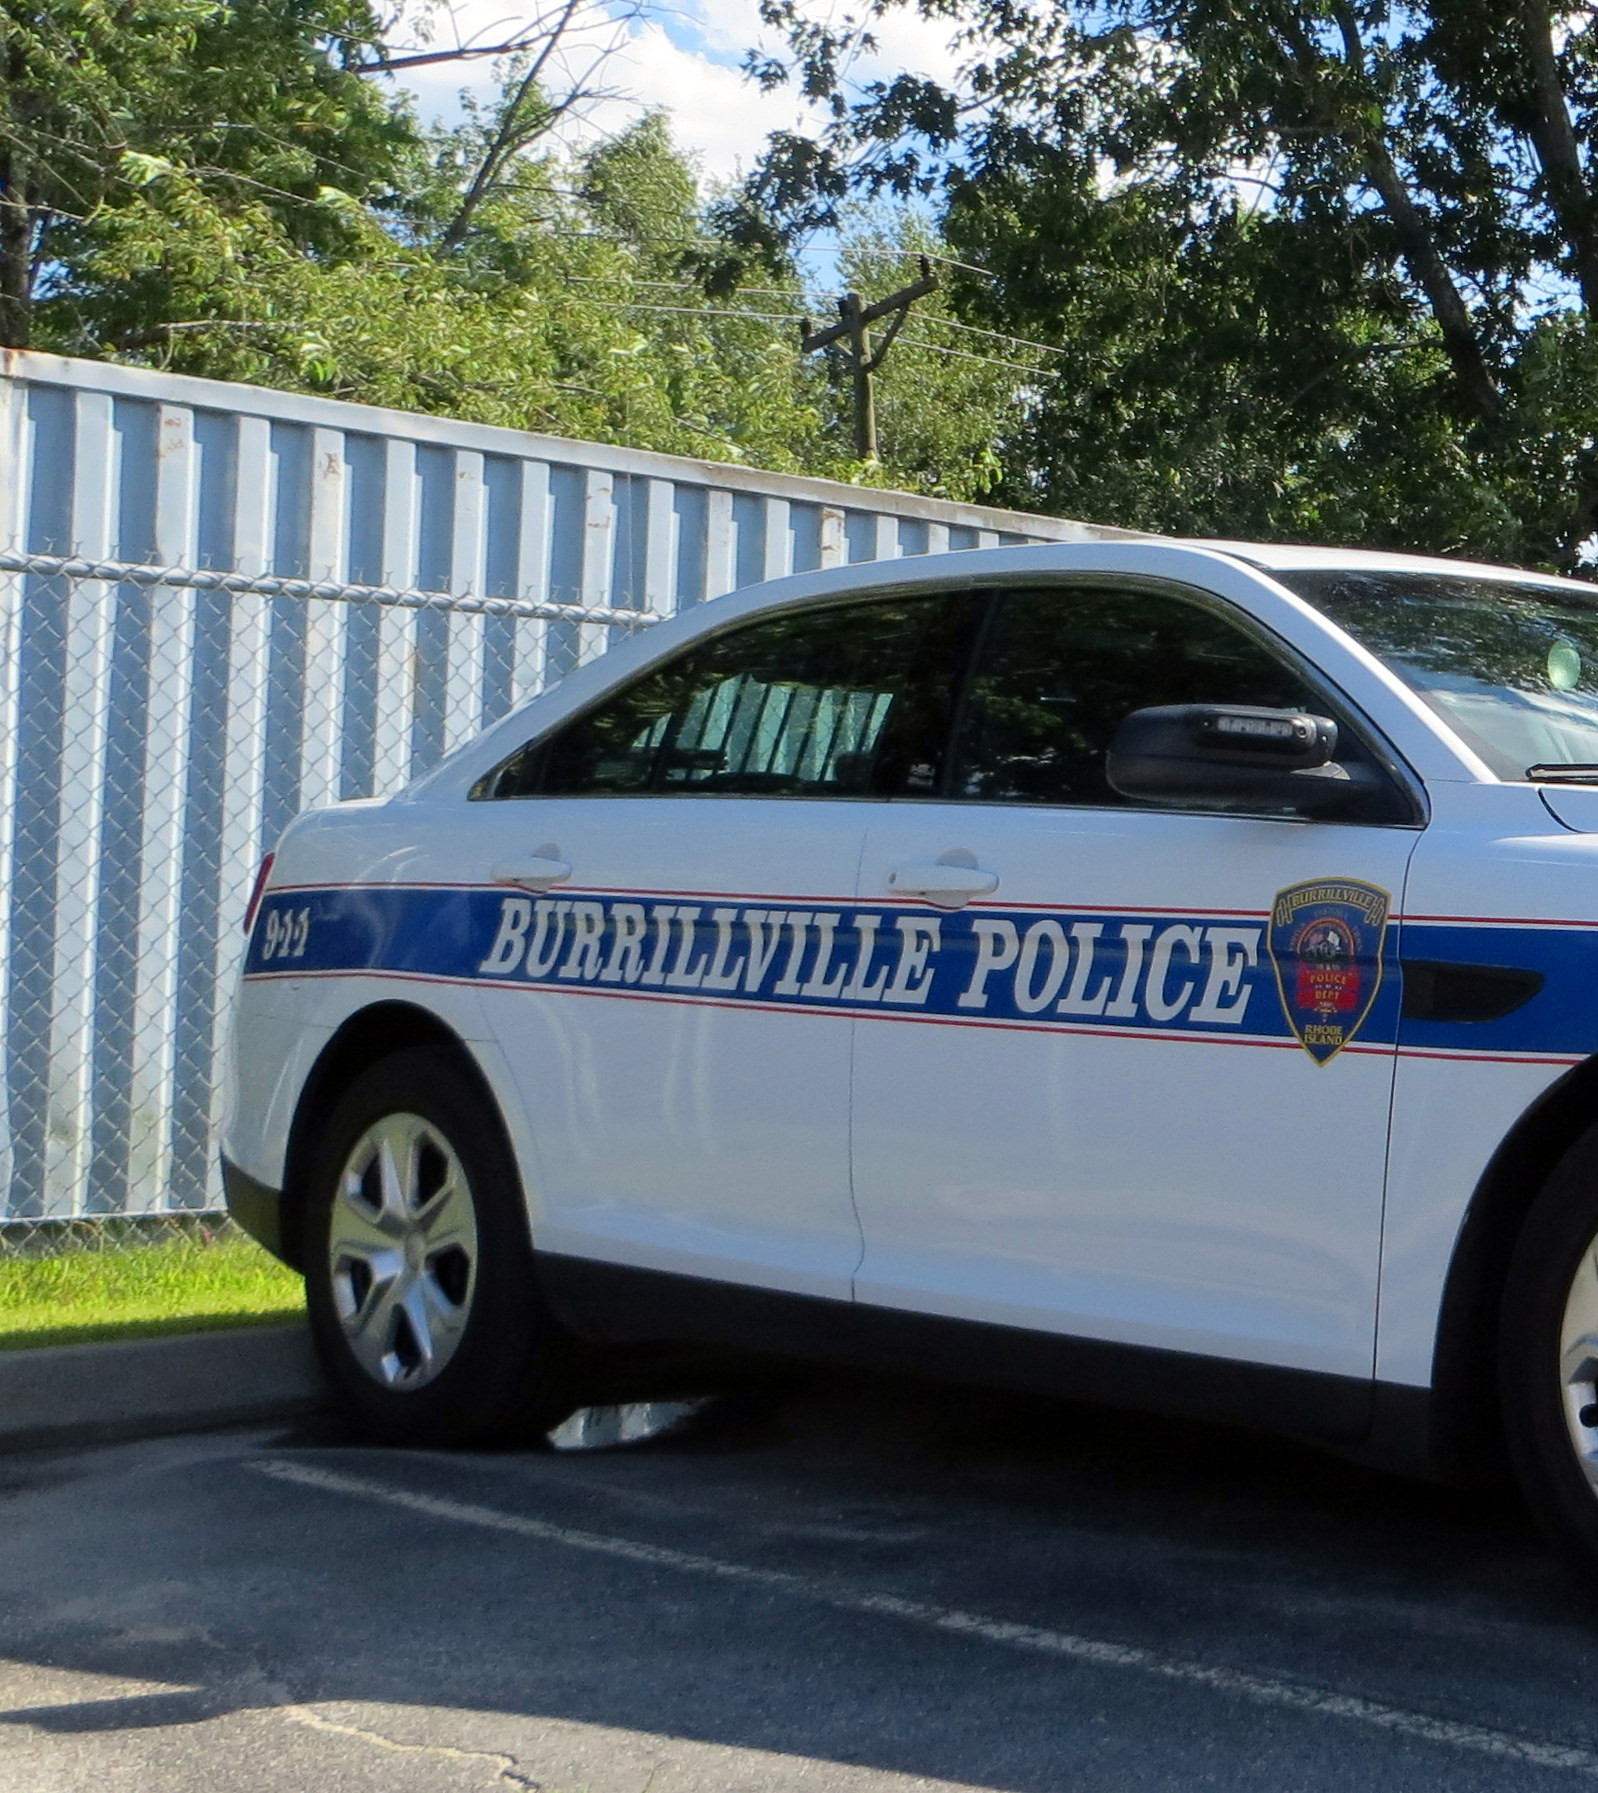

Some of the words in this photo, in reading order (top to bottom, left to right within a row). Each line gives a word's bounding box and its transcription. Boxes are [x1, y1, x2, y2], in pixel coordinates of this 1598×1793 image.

[1291, 887, 1373, 908] BURRILLVILLE
[480, 899, 937, 1003] BURRILLVILLE
[957, 918, 1261, 1024] POLICE
[1310, 973, 1347, 985] POLICE
[1305, 1024, 1343, 1035] RHODE
[1304, 1033, 1343, 1046] ISLAND
